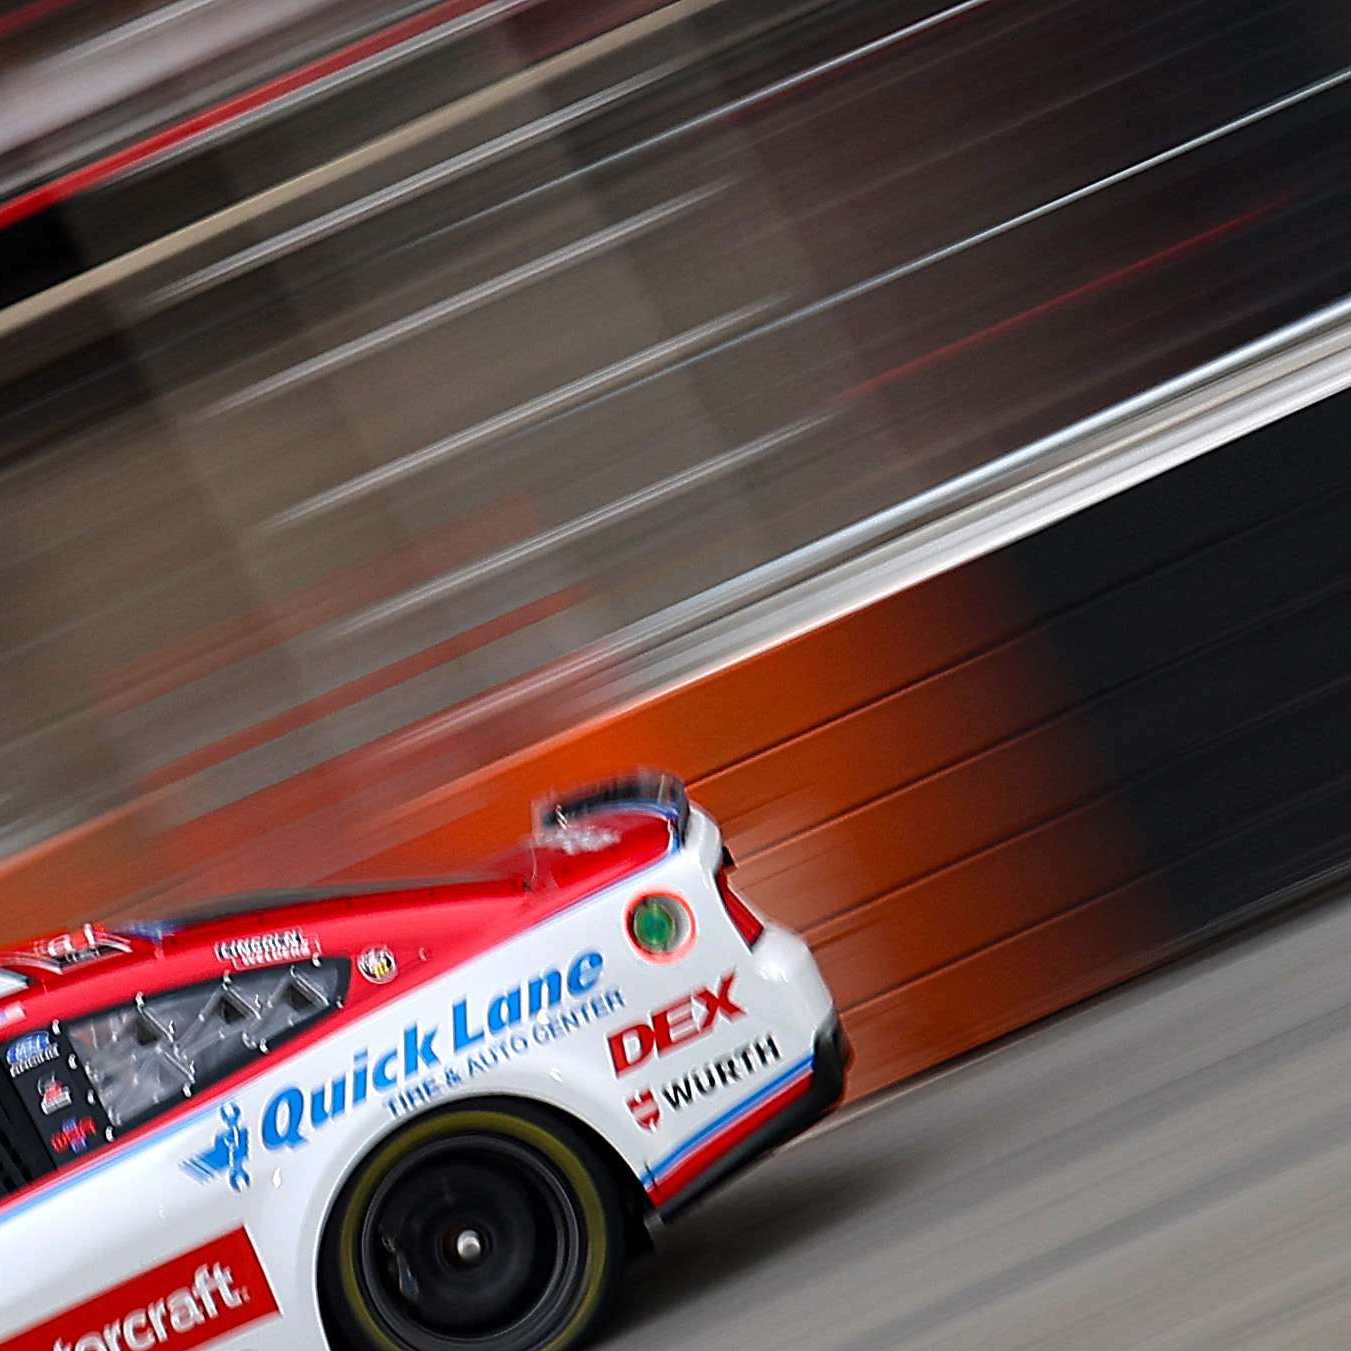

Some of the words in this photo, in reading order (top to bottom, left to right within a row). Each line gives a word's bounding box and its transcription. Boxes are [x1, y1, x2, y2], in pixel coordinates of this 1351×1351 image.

[260, 1019, 440, 1153] Quick
[451, 948, 604, 1054] Lane
[383, 1077, 442, 1119] TIRE
[445, 1067, 462, 1088] &
[466, 1033, 529, 1077] AUTO
[531, 987, 627, 1044] CENTER
[606, 966, 747, 1079] DEX
